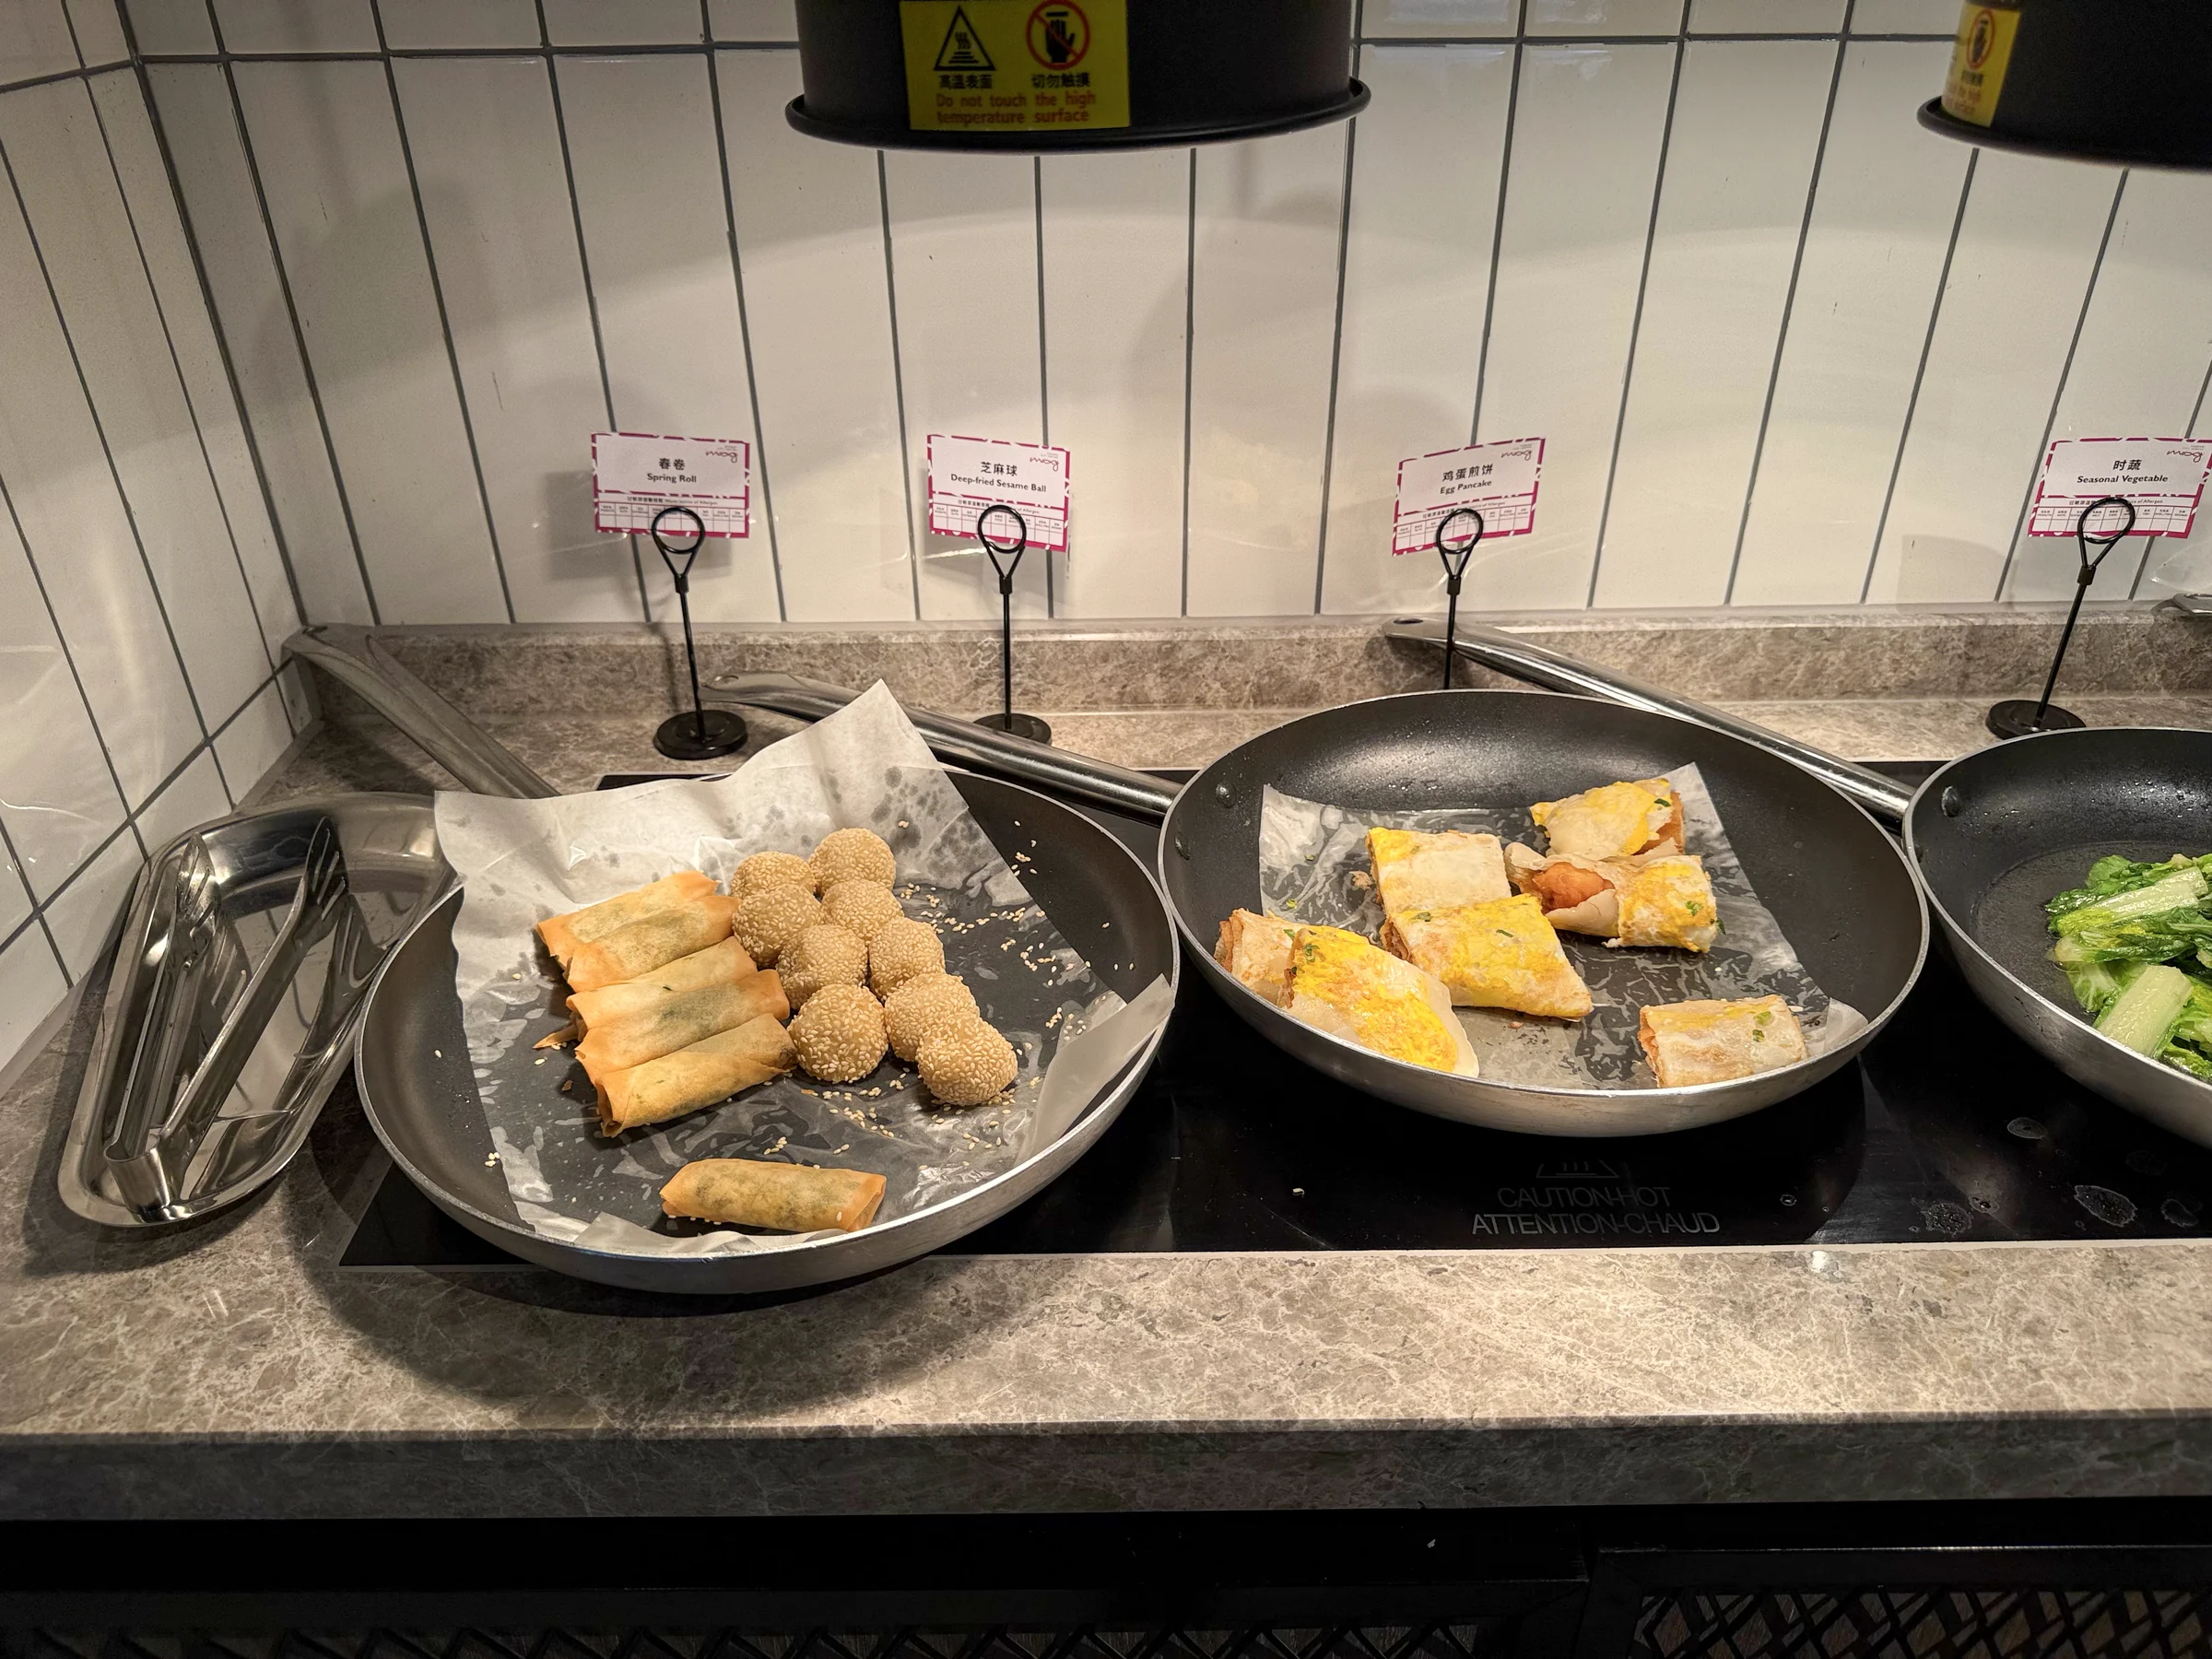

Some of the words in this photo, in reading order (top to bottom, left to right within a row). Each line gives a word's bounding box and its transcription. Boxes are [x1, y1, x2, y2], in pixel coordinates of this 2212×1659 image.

[938, 74, 993, 89] 高温表面
[1030, 72, 1090, 89] 切勿触摸
[936, 93, 954, 108] Do
[961, 95, 982, 108] not
[990, 92, 1027, 108] touch
[1035, 92, 1057, 107] the
[1065, 91, 1096, 109] high
[936, 112, 1026, 127] temperature
[1034, 110, 1089, 124] surface
[658, 457, 686, 471] 春卷
[981, 461, 1018, 477] 芝麻球
[2112, 459, 2143, 471] 时蔬
[647, 473, 677, 484] Spring
[679, 475, 698, 484] Roll
[1441, 463, 1493, 482] 鸡蛋煎饼
[2077, 475, 2120, 484] Seasonal
[2122, 475, 2169, 484] Vegetable
[950, 473, 994, 487] Deep-fried
[996, 478, 1030, 491] Sesame
[1030, 483, 1047, 493] Ball
[1440, 486, 1455, 495] Egg
[1457, 480, 1492, 491] Pancake
[1497, 1186, 1671, 1207] CAUTION-HOT
[1472, 1212, 1721, 1235] ATTENTION-CHAUD
